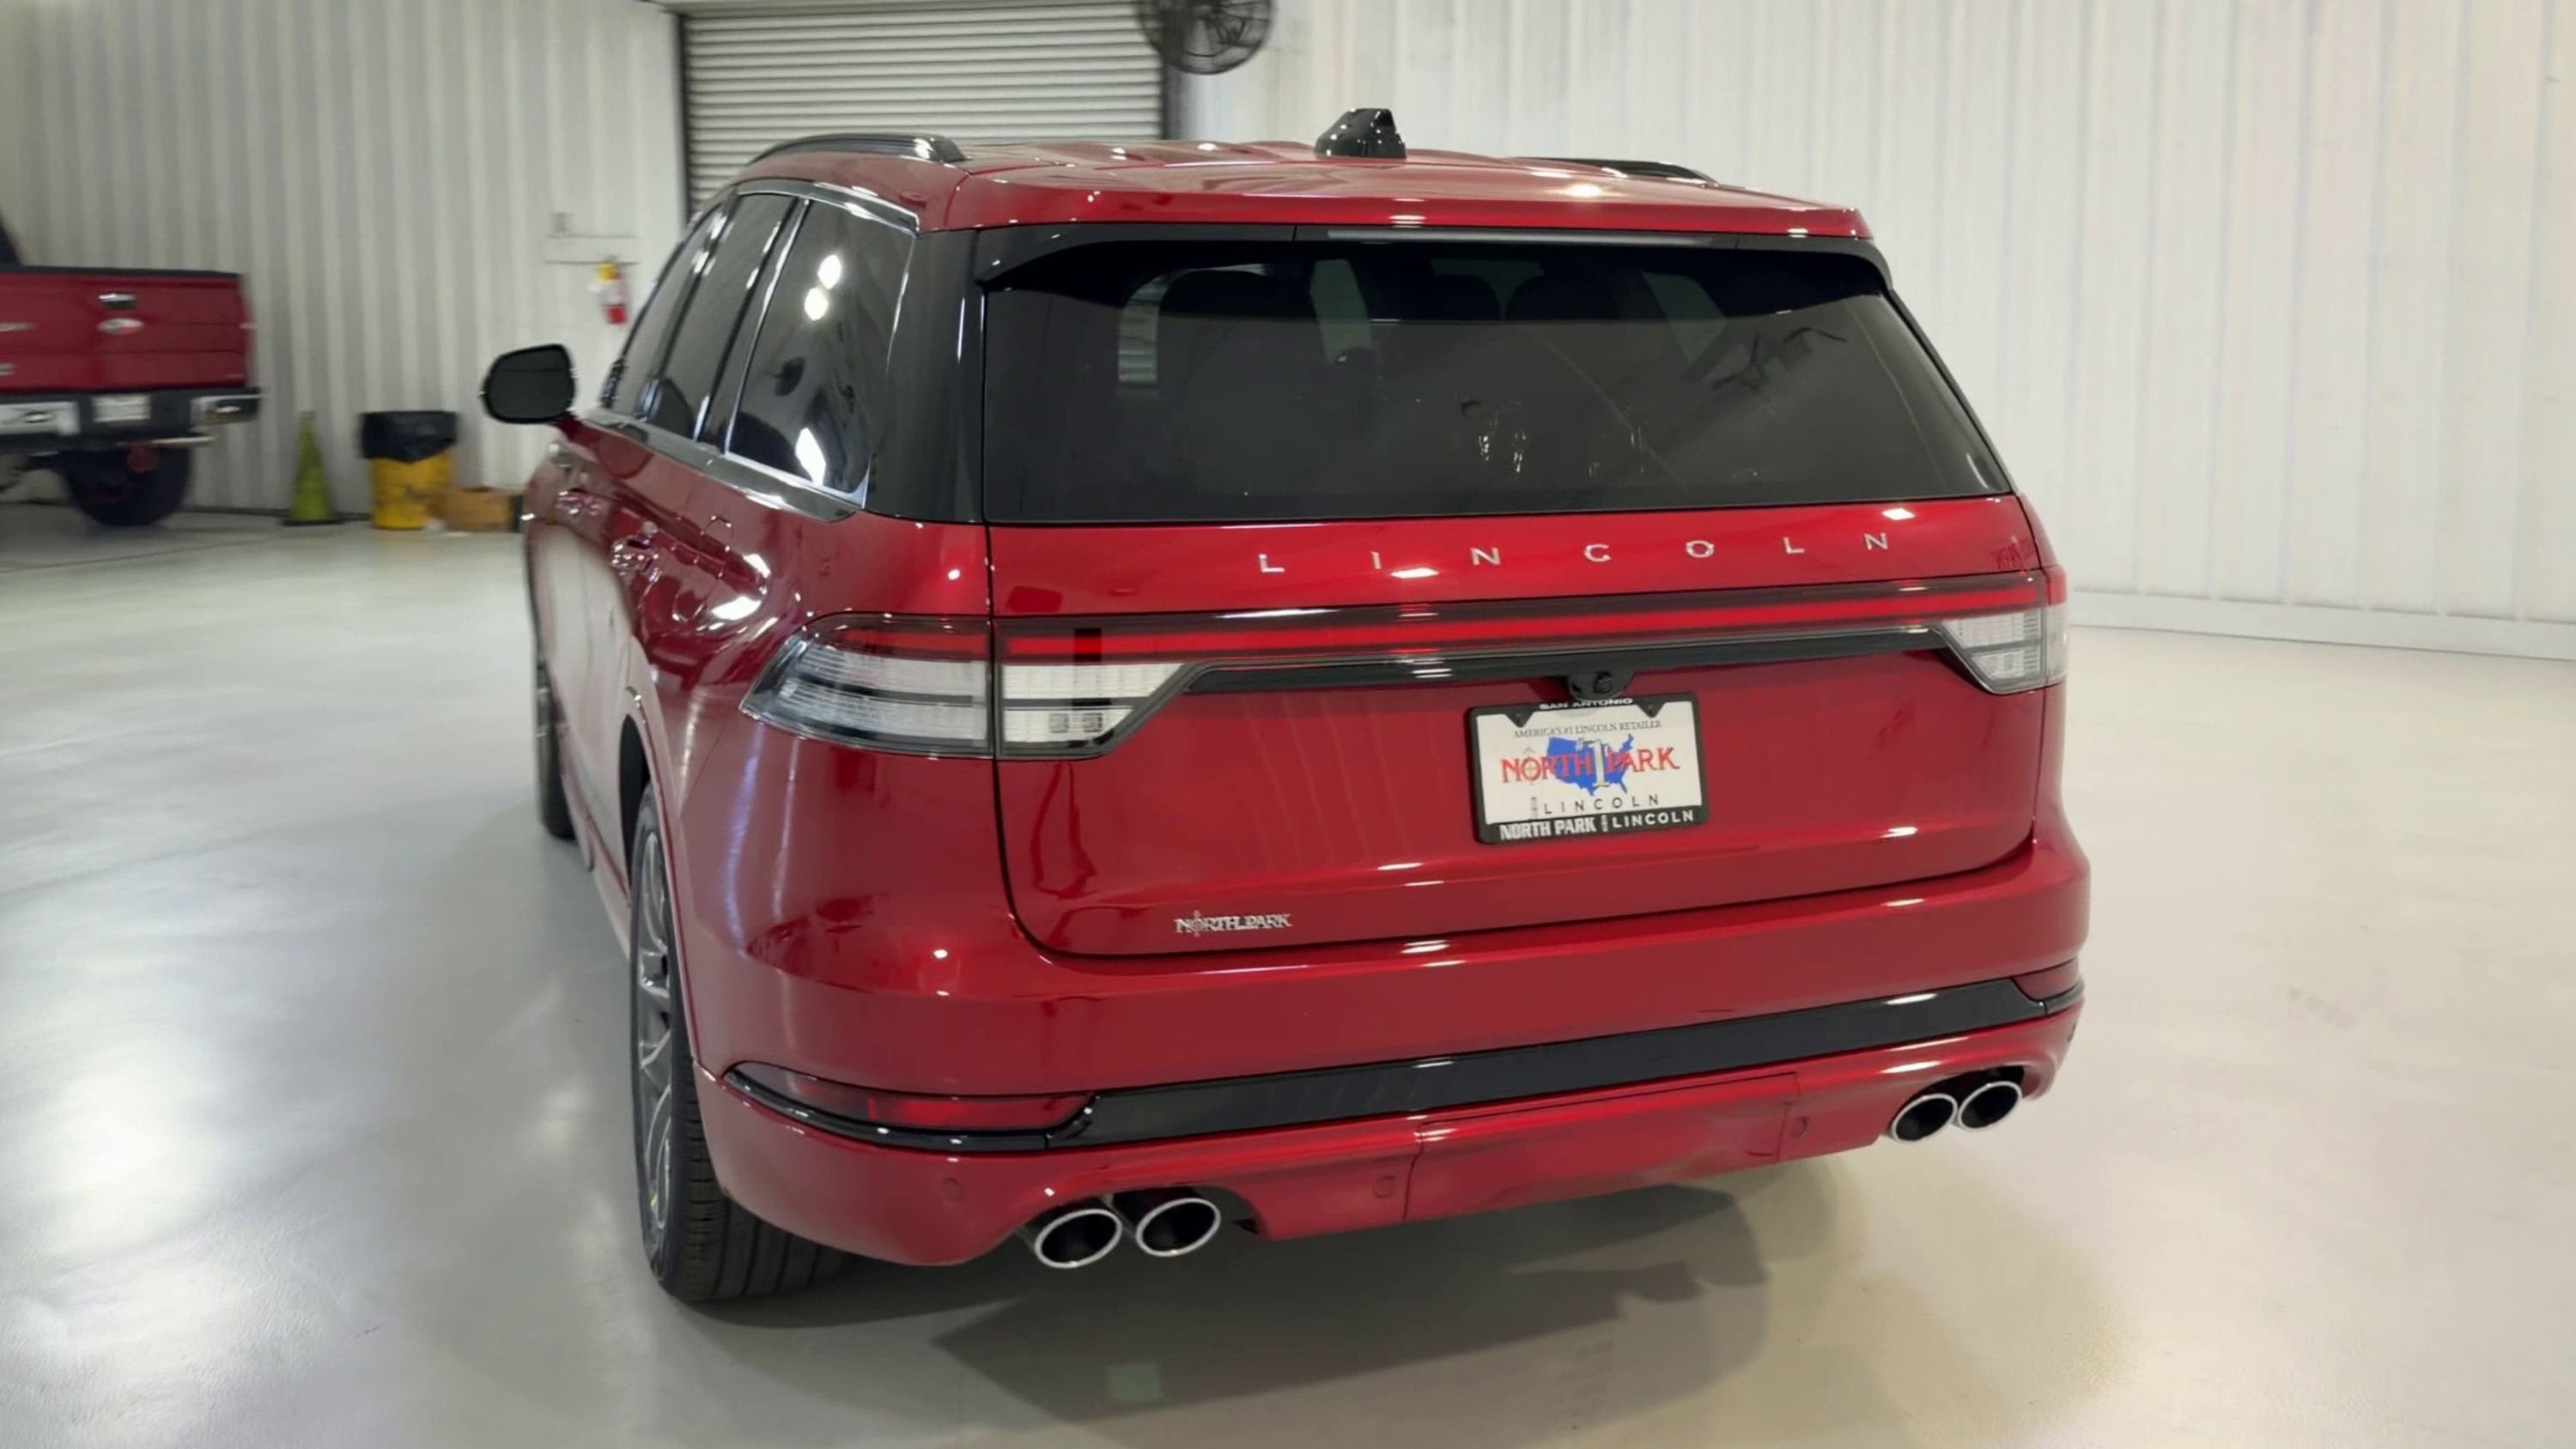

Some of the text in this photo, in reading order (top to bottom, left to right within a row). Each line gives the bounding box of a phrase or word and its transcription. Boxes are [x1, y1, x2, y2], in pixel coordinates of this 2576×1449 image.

[1259, 530, 1890, 573] LINCOLN
[1539, 697, 1633, 711] SAN ANTONIO
[1513, 727, 1563, 738] AMERICA'S
[1575, 724, 1616, 735] LINCOLN
[1619, 719, 1662, 731] RETAILER
[1499, 746, 1680, 783] NORTH PARK
[1544, 795, 1659, 815] LINCOLN
[1499, 809, 1694, 841] NORTH PARK LINCOLN
[1174, 913, 1293, 934] NORTH PARK
